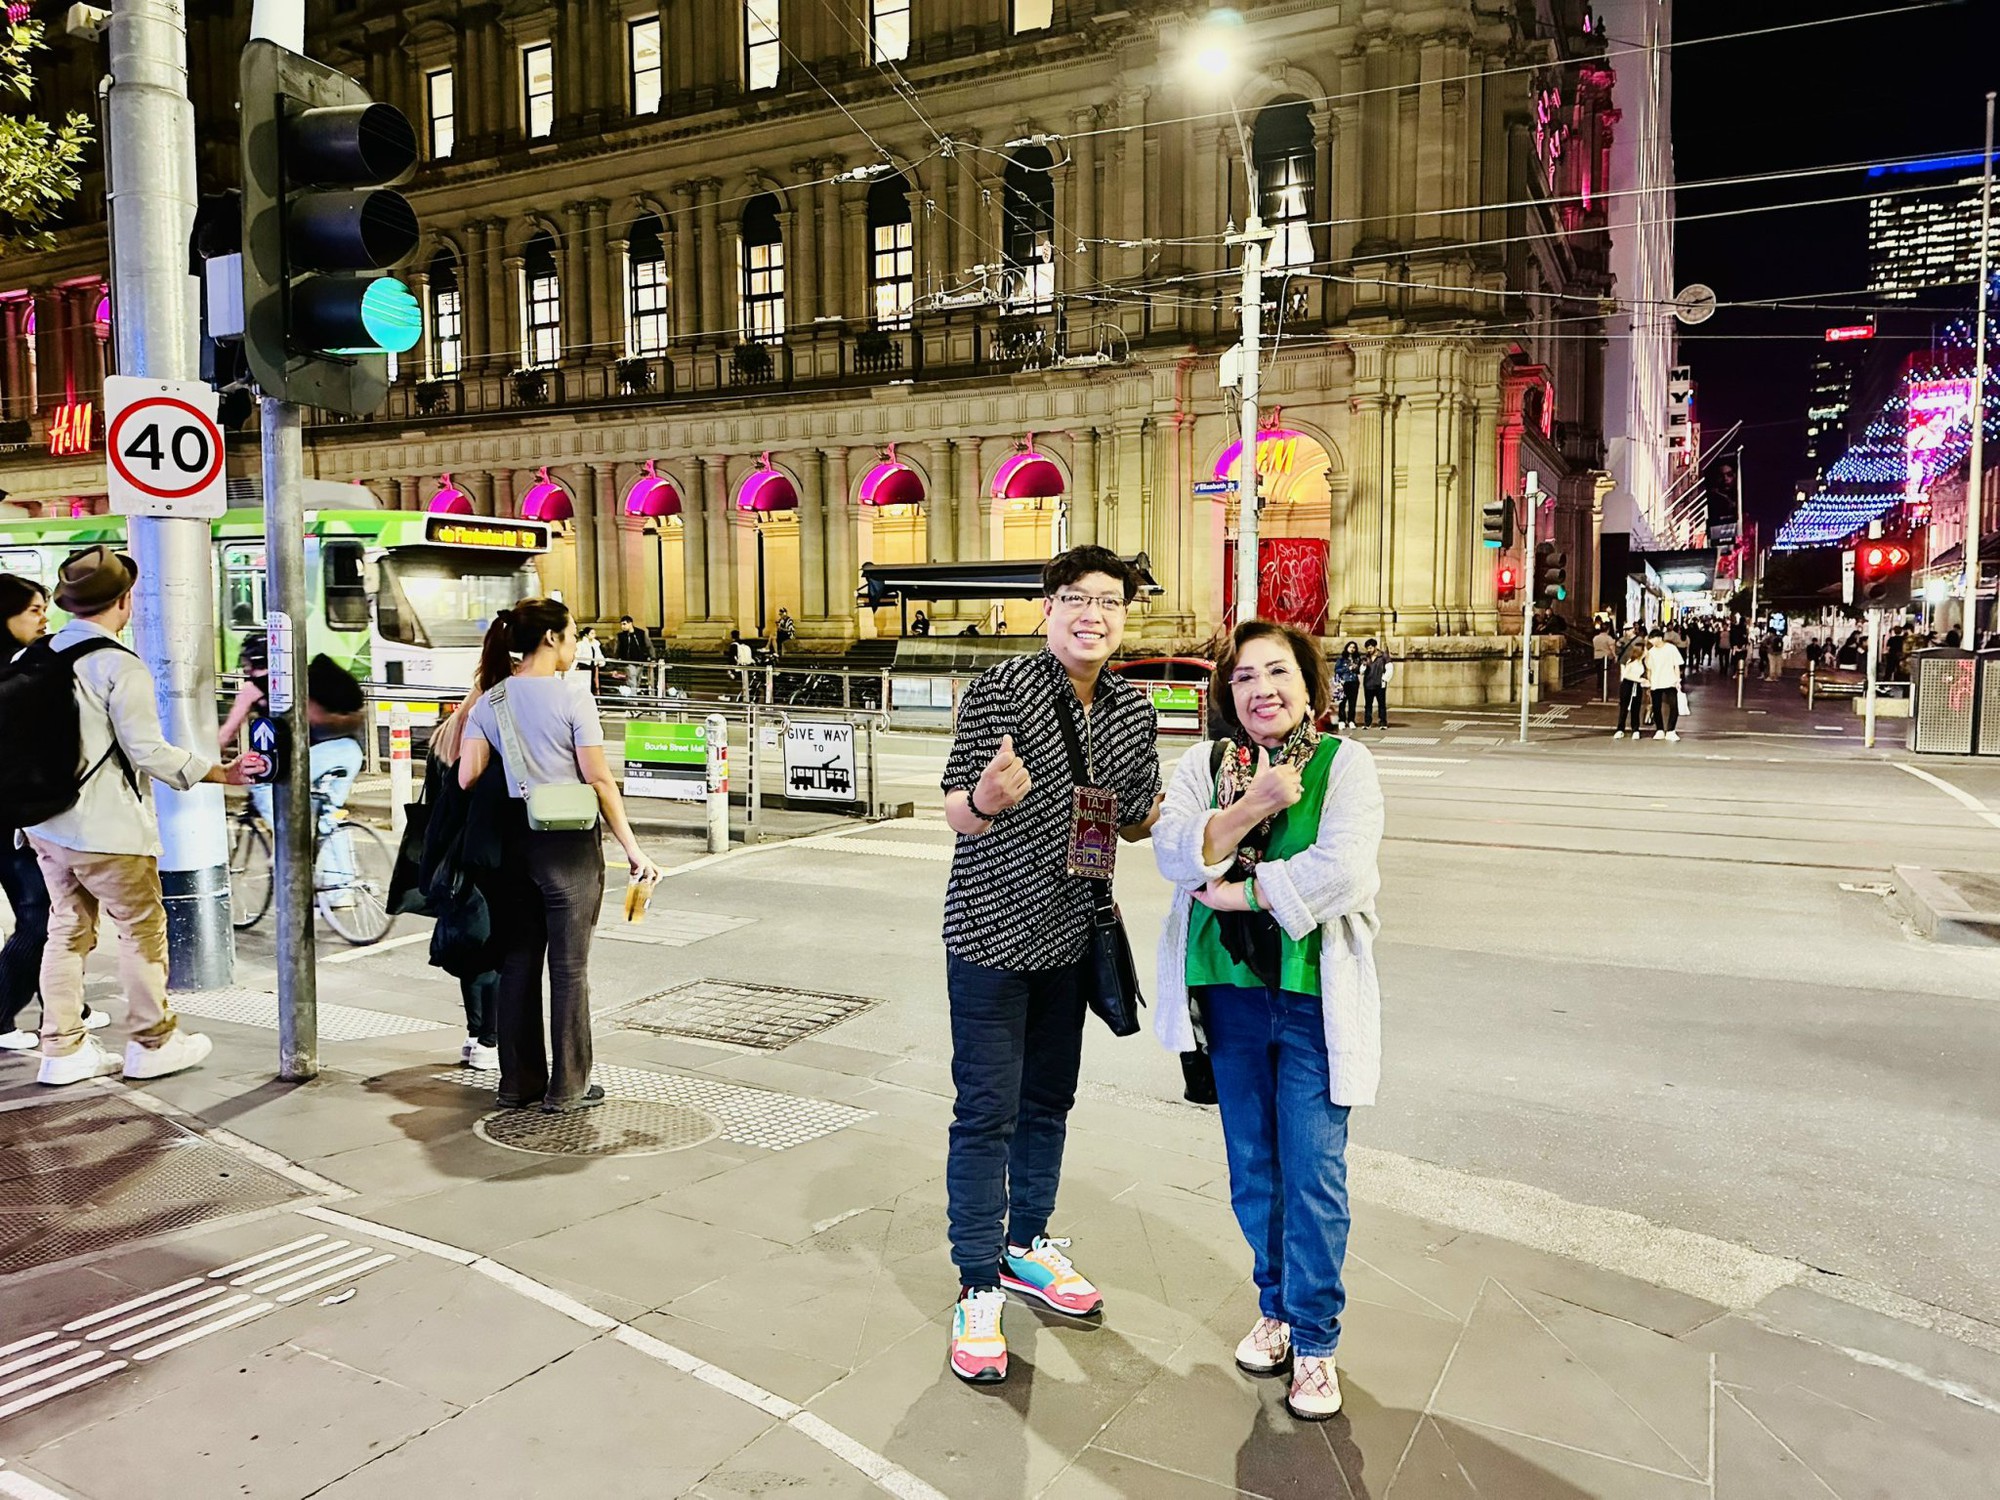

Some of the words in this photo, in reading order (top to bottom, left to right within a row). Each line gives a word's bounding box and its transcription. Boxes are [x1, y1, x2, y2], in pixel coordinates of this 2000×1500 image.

[1669, 369, 1689, 448] MYER
[49, 402, 92, 455] H&M
[124, 423, 209, 473] 40
[787, 728, 814, 740] GIVE
[824, 730, 848, 742] WAY
[644, 742, 668, 751] Bourke
[669, 743, 689, 752] Street
[691, 744, 705, 753] Mall
[813, 744, 824, 752] TO
[697, 785, 703, 795] 3
[1085, 795, 1108, 810] TAJ
[1079, 809, 1111, 823] MAHAL
